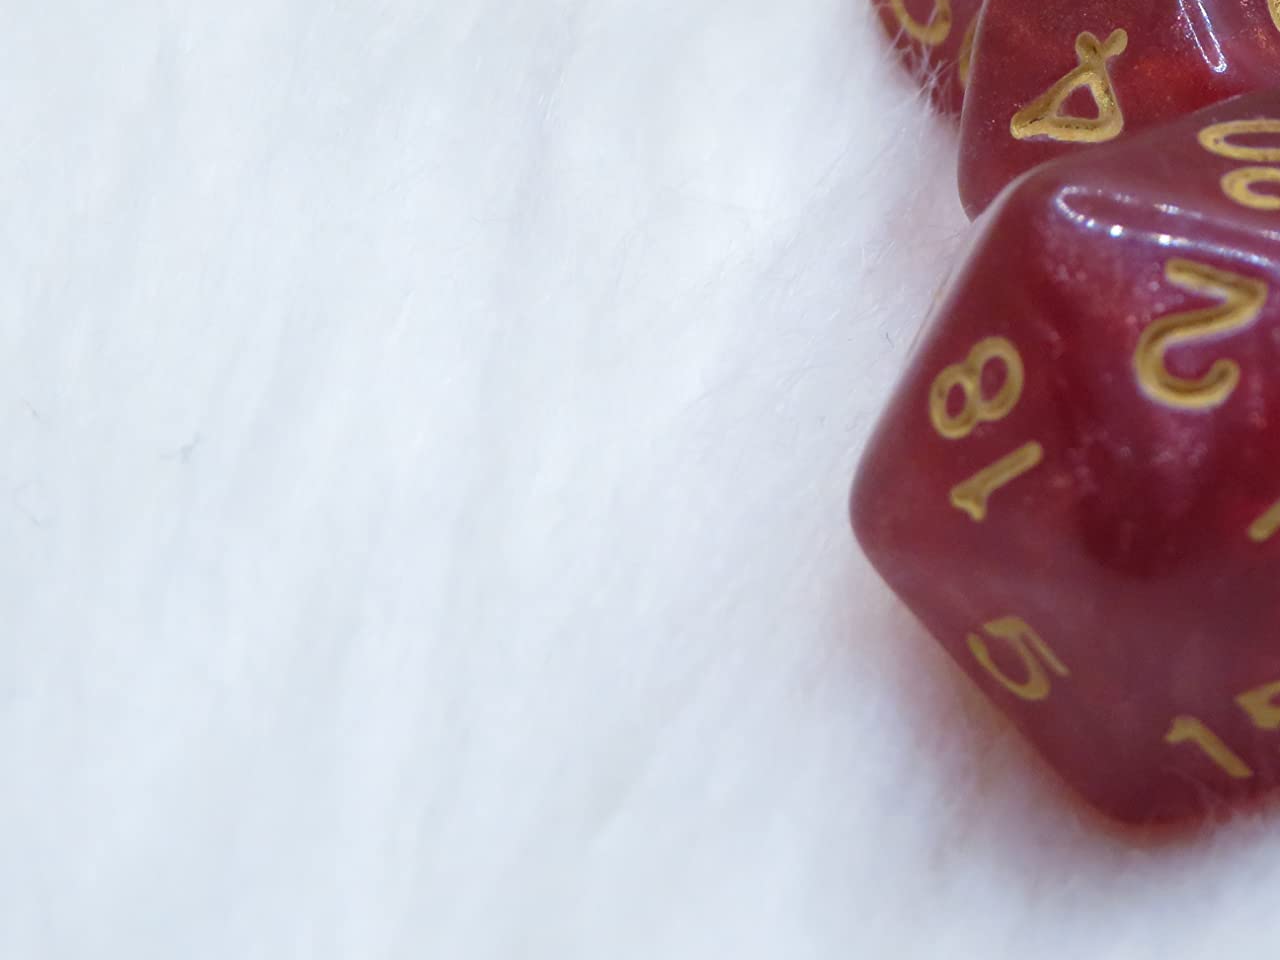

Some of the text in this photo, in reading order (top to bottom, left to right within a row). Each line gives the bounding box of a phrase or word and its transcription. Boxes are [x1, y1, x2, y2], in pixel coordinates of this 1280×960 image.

[1008, 25, 1130, 144] 4
[1131, 257, 1269, 411] 2
[927, 335, 1044, 522] 18
[966, 614, 1071, 702] 5
